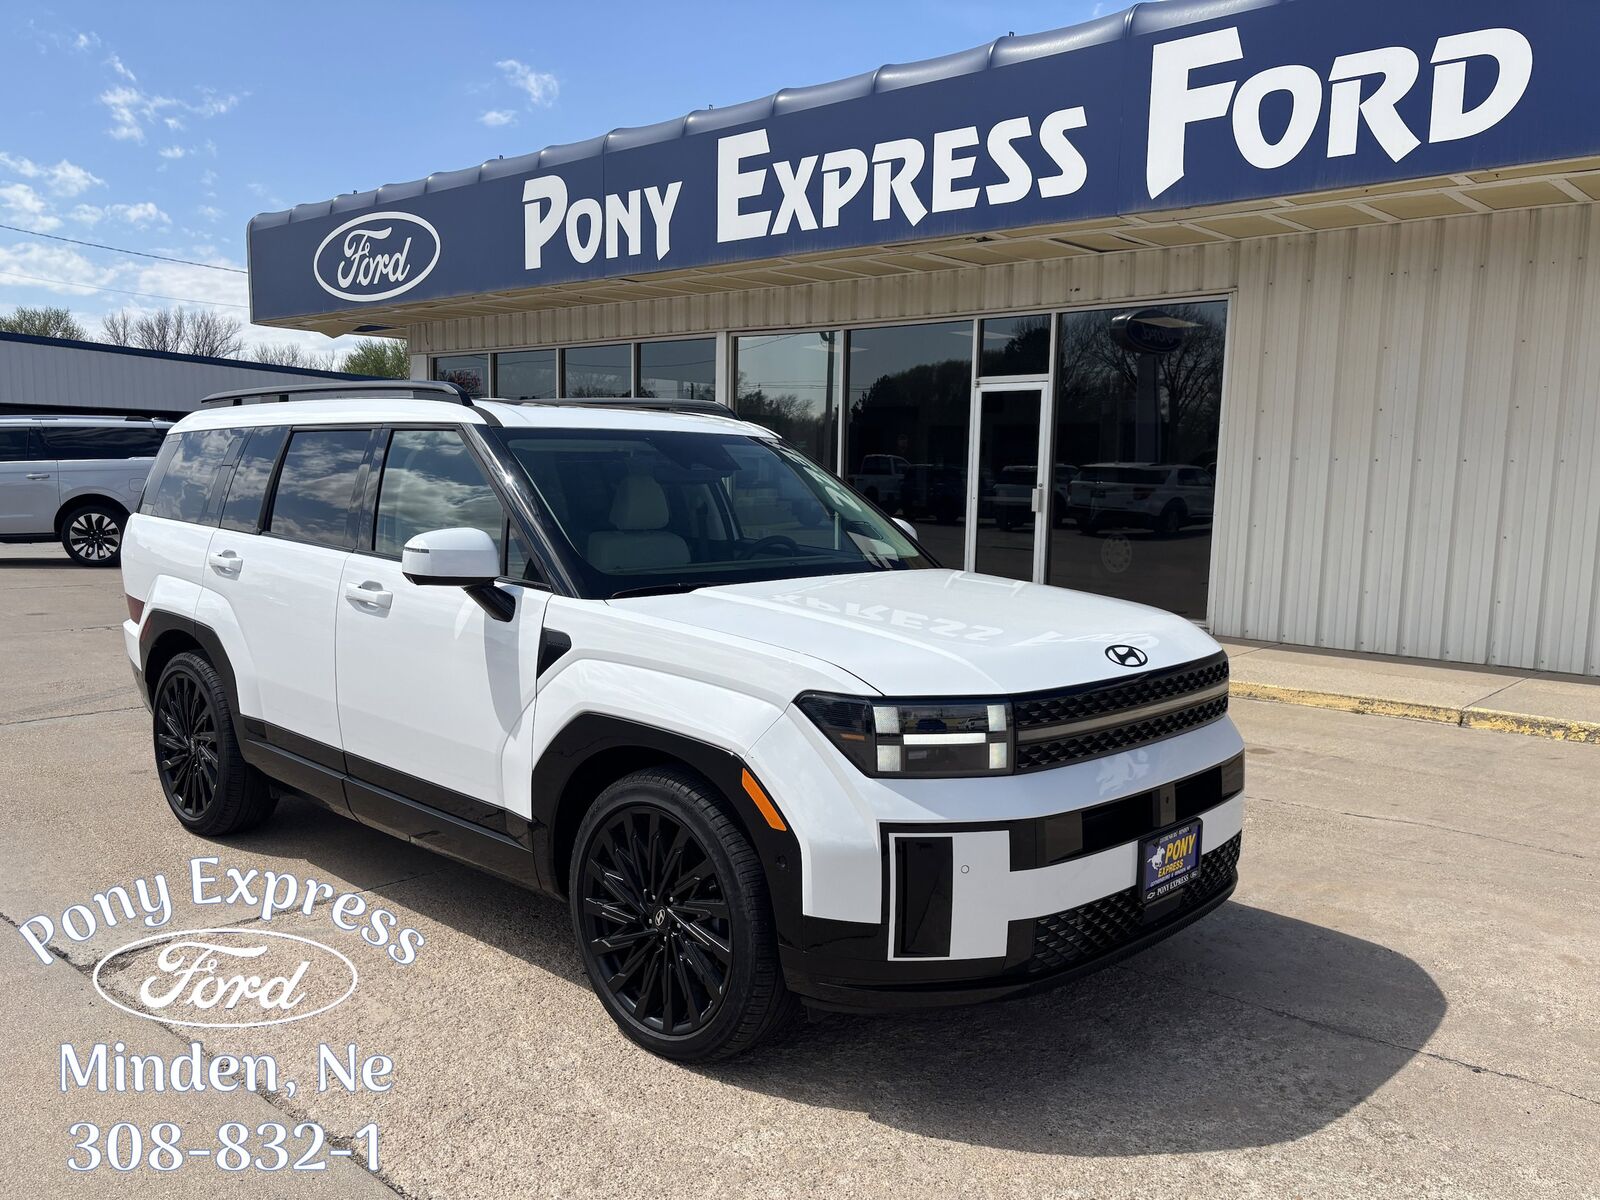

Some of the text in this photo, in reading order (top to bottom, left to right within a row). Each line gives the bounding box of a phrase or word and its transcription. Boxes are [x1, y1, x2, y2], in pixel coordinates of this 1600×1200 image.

[522, 27, 1534, 271] PONY EXPRESS FORD
[336, 226, 412, 289] Ford
[1158, 859, 1184, 877] EXPRESS
[1165, 833, 1196, 864] PONY
